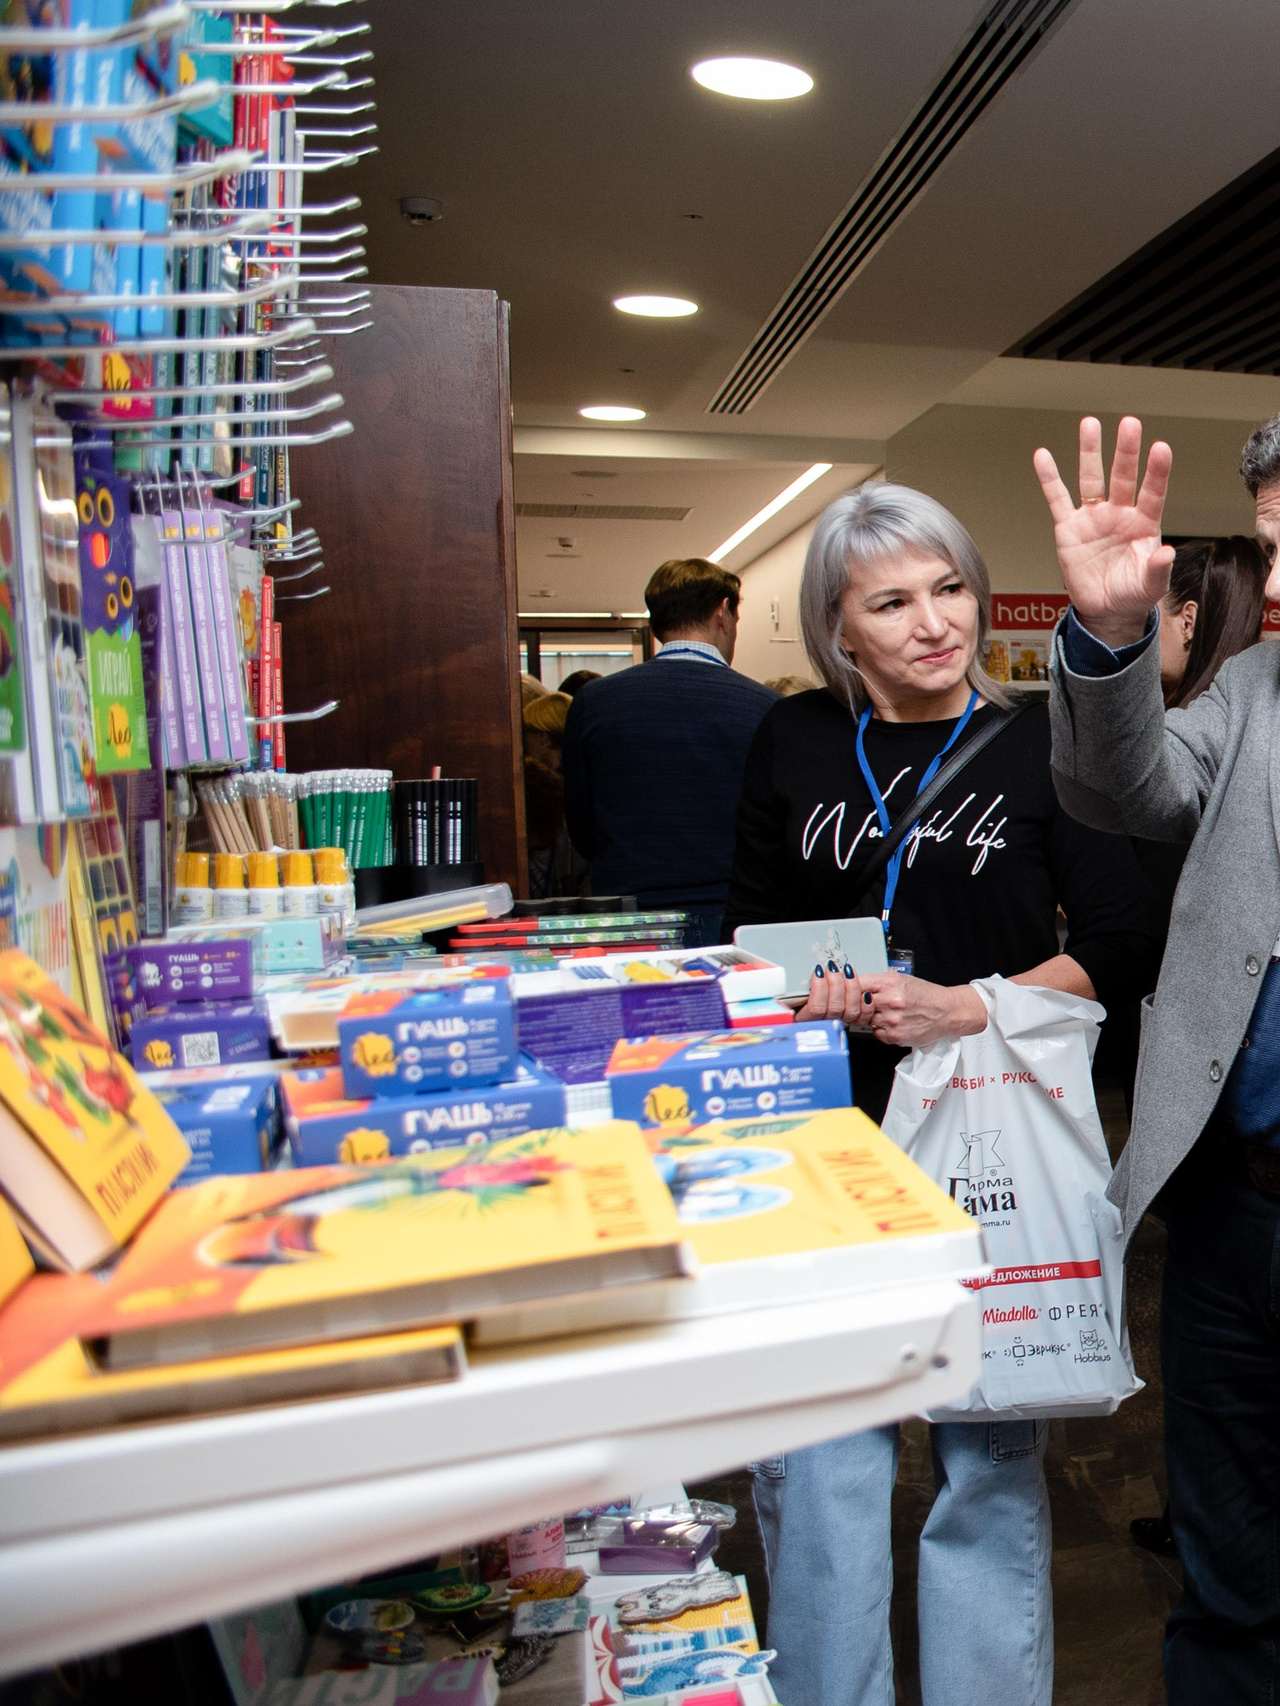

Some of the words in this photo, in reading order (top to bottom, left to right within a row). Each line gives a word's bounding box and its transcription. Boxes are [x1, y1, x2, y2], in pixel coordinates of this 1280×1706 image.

[997, 601, 1068, 623] hatbe
[182, 673, 194, 706] ДЖАМБО
[188, 722, 197, 744] ШТУК
[205, 671, 216, 704] ДЖАМБО
[211, 720, 219, 741] ШТУК
[225, 672, 236, 704] ДЖАМБО
[232, 720, 241, 742] ШТУК
[170, 727, 179, 749] ШТУК
[966, 793, 1008, 876] life
[169, 953, 200, 963] ГУАШЬ
[398, 1016, 470, 1042] ГУАШЬ
[702, 1064, 781, 1092] ГУАШЬ
[404, 1102, 493, 1135] ГУАШЬ
[982, 1305, 1039, 1326] Miadolla
[1048, 1304, 1099, 1321] ФРЕЯ
[1074, 1353, 1112, 1364] Hobbius
